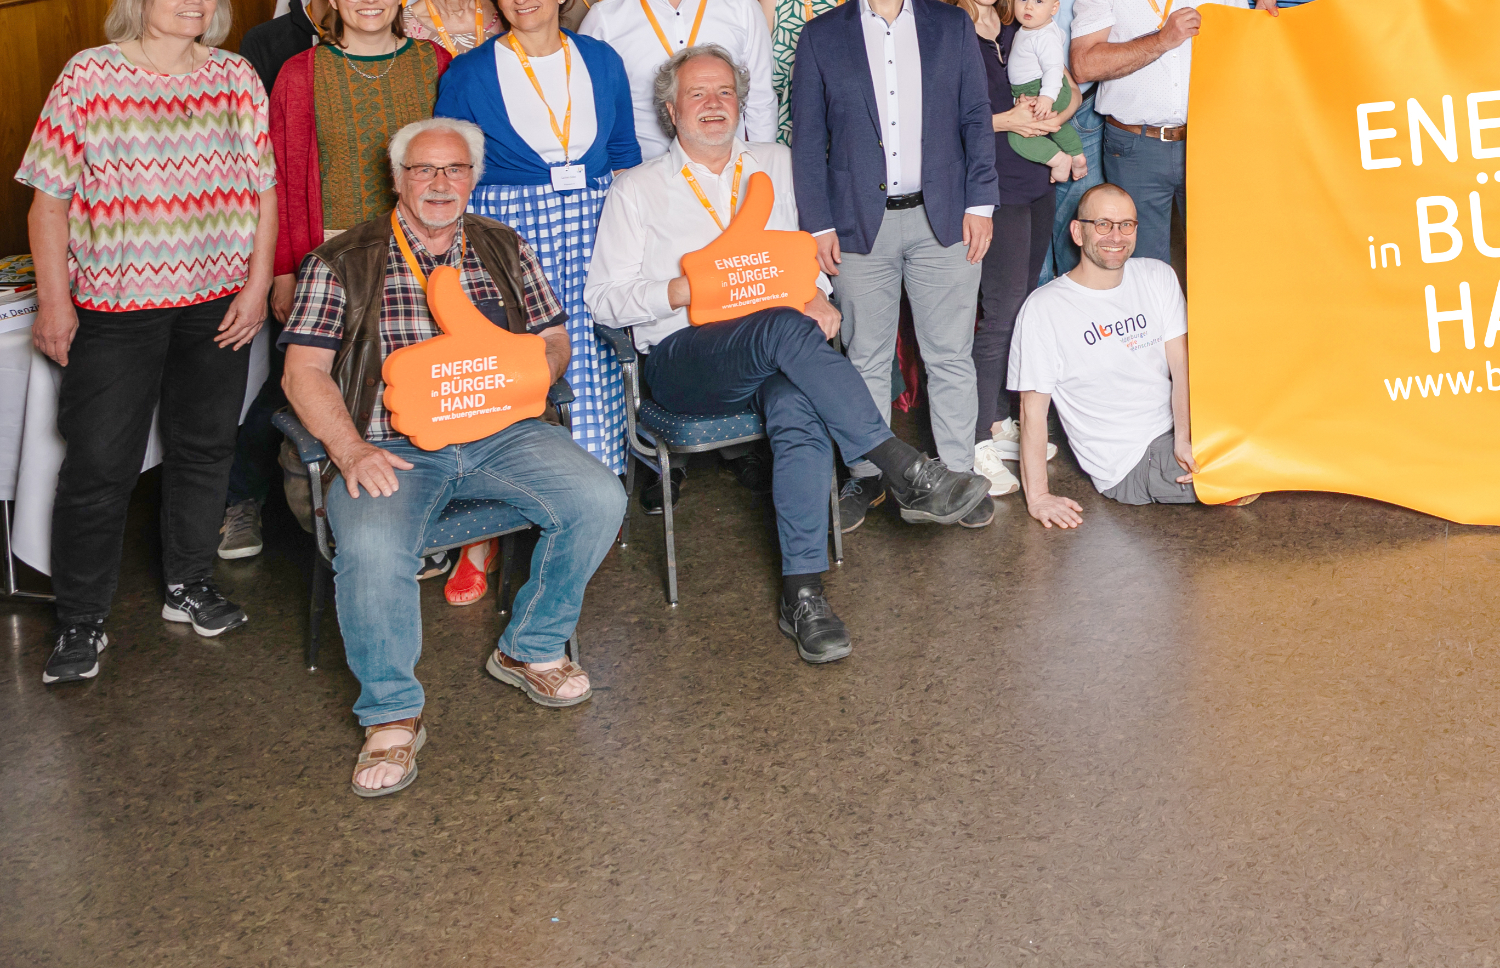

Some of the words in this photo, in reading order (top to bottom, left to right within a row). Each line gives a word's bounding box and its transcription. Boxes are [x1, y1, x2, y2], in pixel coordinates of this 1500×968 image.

[714, 251, 771, 270] ENERGIE
[1367, 236, 1402, 270] in
[721, 280, 728, 288] in
[728, 266, 785, 286] BÜRGER-
[730, 282, 766, 302] HAND
[9, 302, 40, 318] Denzi
[431, 355, 498, 379] ENERGIE
[431, 390, 439, 398] in
[440, 373, 514, 396] BÜRGER-
[440, 393, 486, 413] HAND
[431, 404, 512, 423] www.buergerwerke.de
